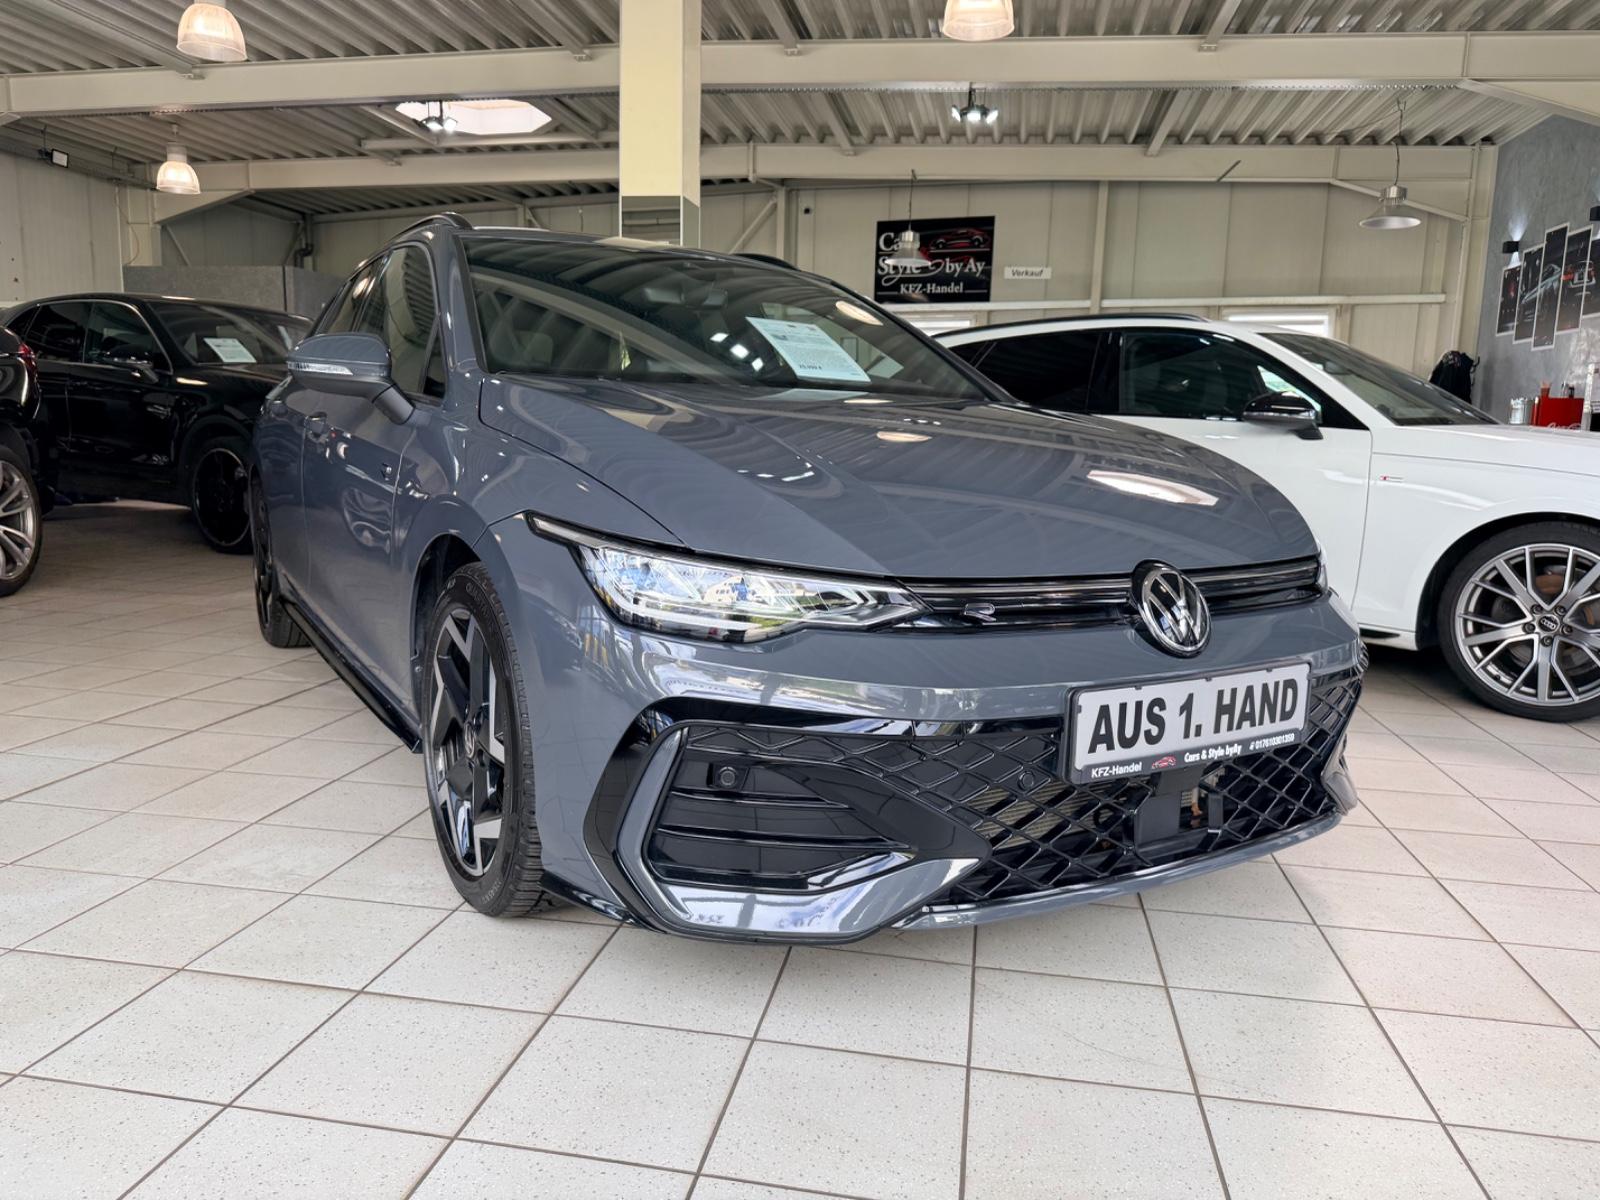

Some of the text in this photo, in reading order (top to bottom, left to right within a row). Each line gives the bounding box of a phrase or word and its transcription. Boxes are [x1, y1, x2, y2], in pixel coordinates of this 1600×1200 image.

[946, 258, 964, 278] by
[965, 257, 986, 277] Ay
[1011, 268, 1043, 278] Verkauf
[900, 282, 964, 295] KFZ-Handel
[1088, 679, 1298, 754] AUS 1. HAND
[1091, 761, 1143, 779] KFZ-Handel
